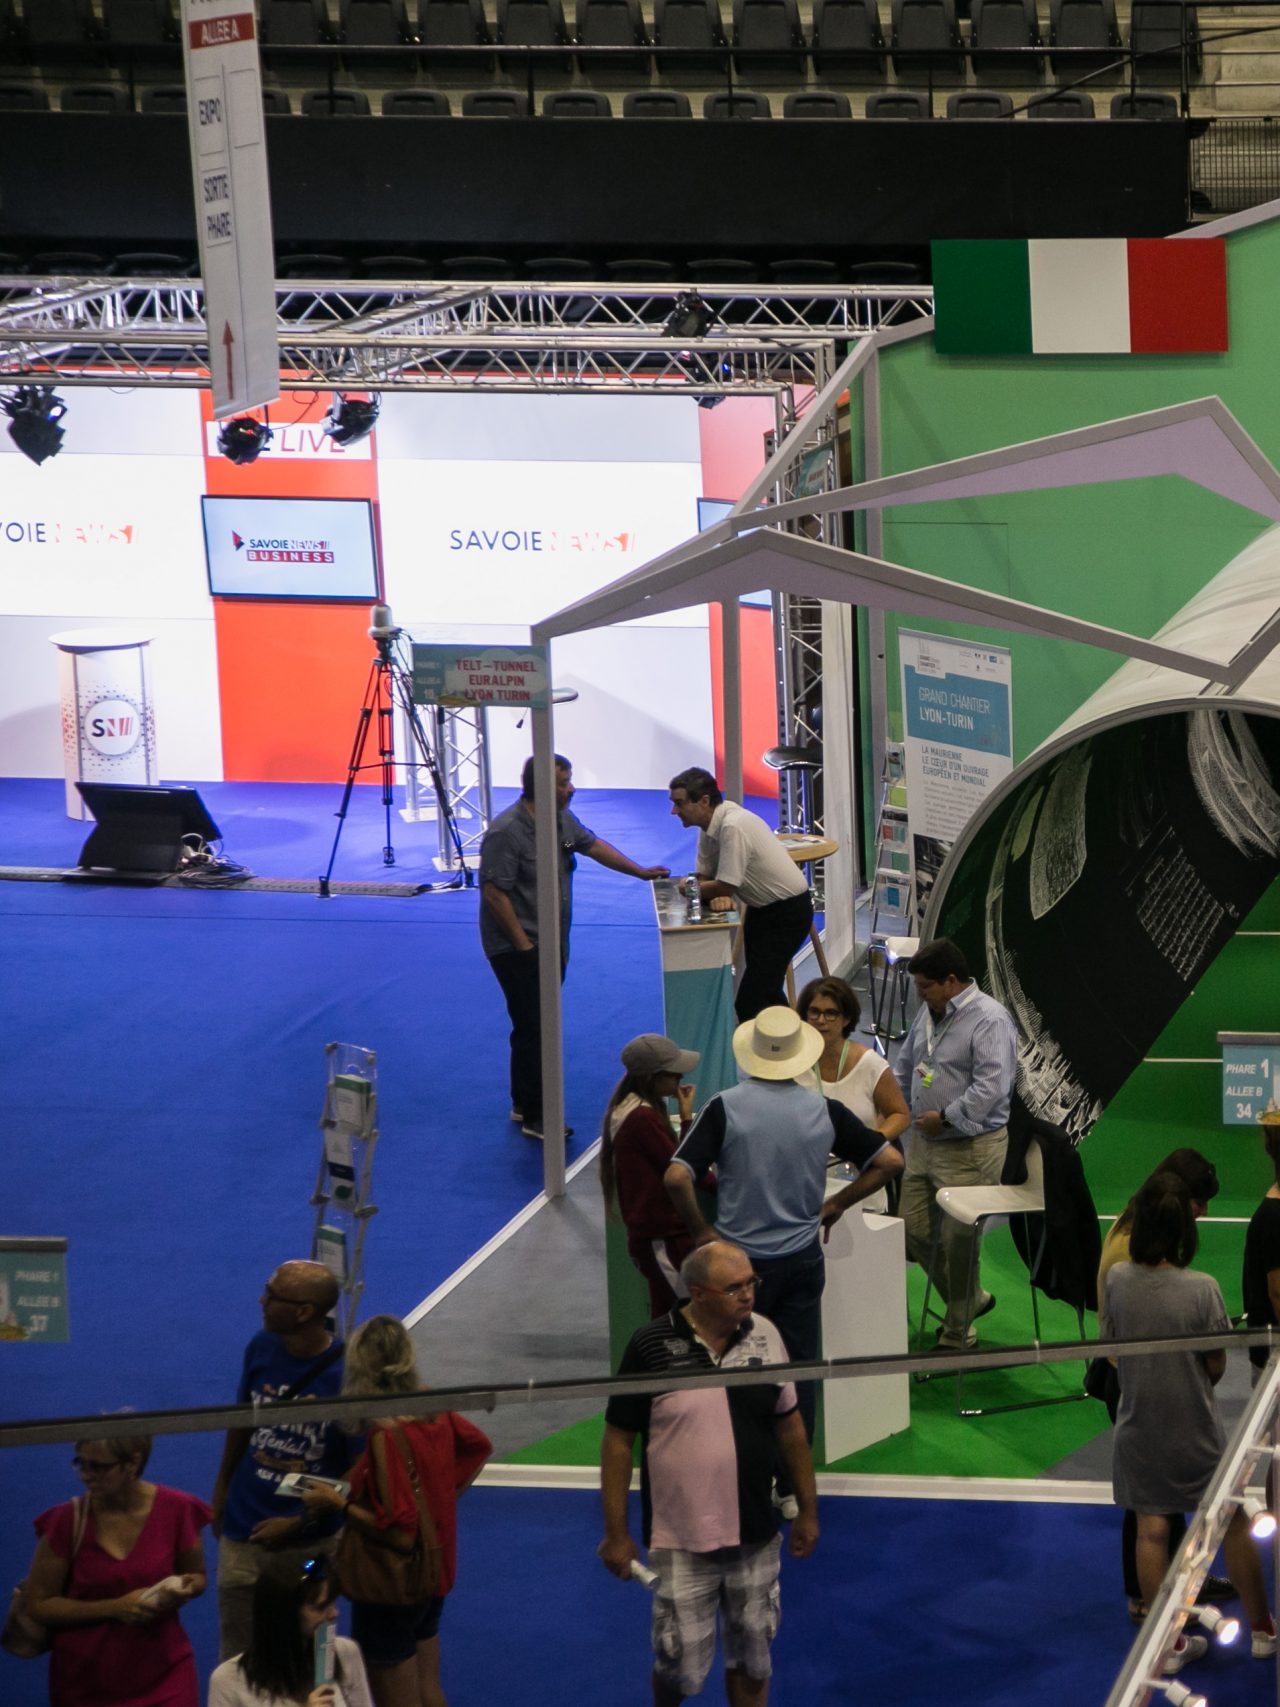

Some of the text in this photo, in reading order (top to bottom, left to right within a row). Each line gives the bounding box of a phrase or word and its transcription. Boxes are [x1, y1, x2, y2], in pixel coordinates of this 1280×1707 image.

[198, 98, 221, 126] EXPO
[203, 173, 229, 203] SORTIE
[207, 211, 231, 240] PHARE
[249, 538, 289, 550] SAVOIE
[450, 529, 543, 552] SAVOIE
[248, 551, 333, 563] BUSINESS
[469, 674, 525, 687] EURALPIN
[496, 689, 530, 701] TURIN
[919, 686, 991, 714] GRAND CHANTIER
[919, 706, 974, 731] LYON-TURIN
[922, 745, 963, 761] LA MAURIENNE
[922, 755, 929, 764] LE
[963, 763, 990, 777] OUVRAGE
[953, 772, 960, 781] ET
[1226, 1058, 1269, 1079] PHARE 1
[1225, 1085, 1263, 1097] ALLEE B
[1236, 1102, 1251, 1119] 34
